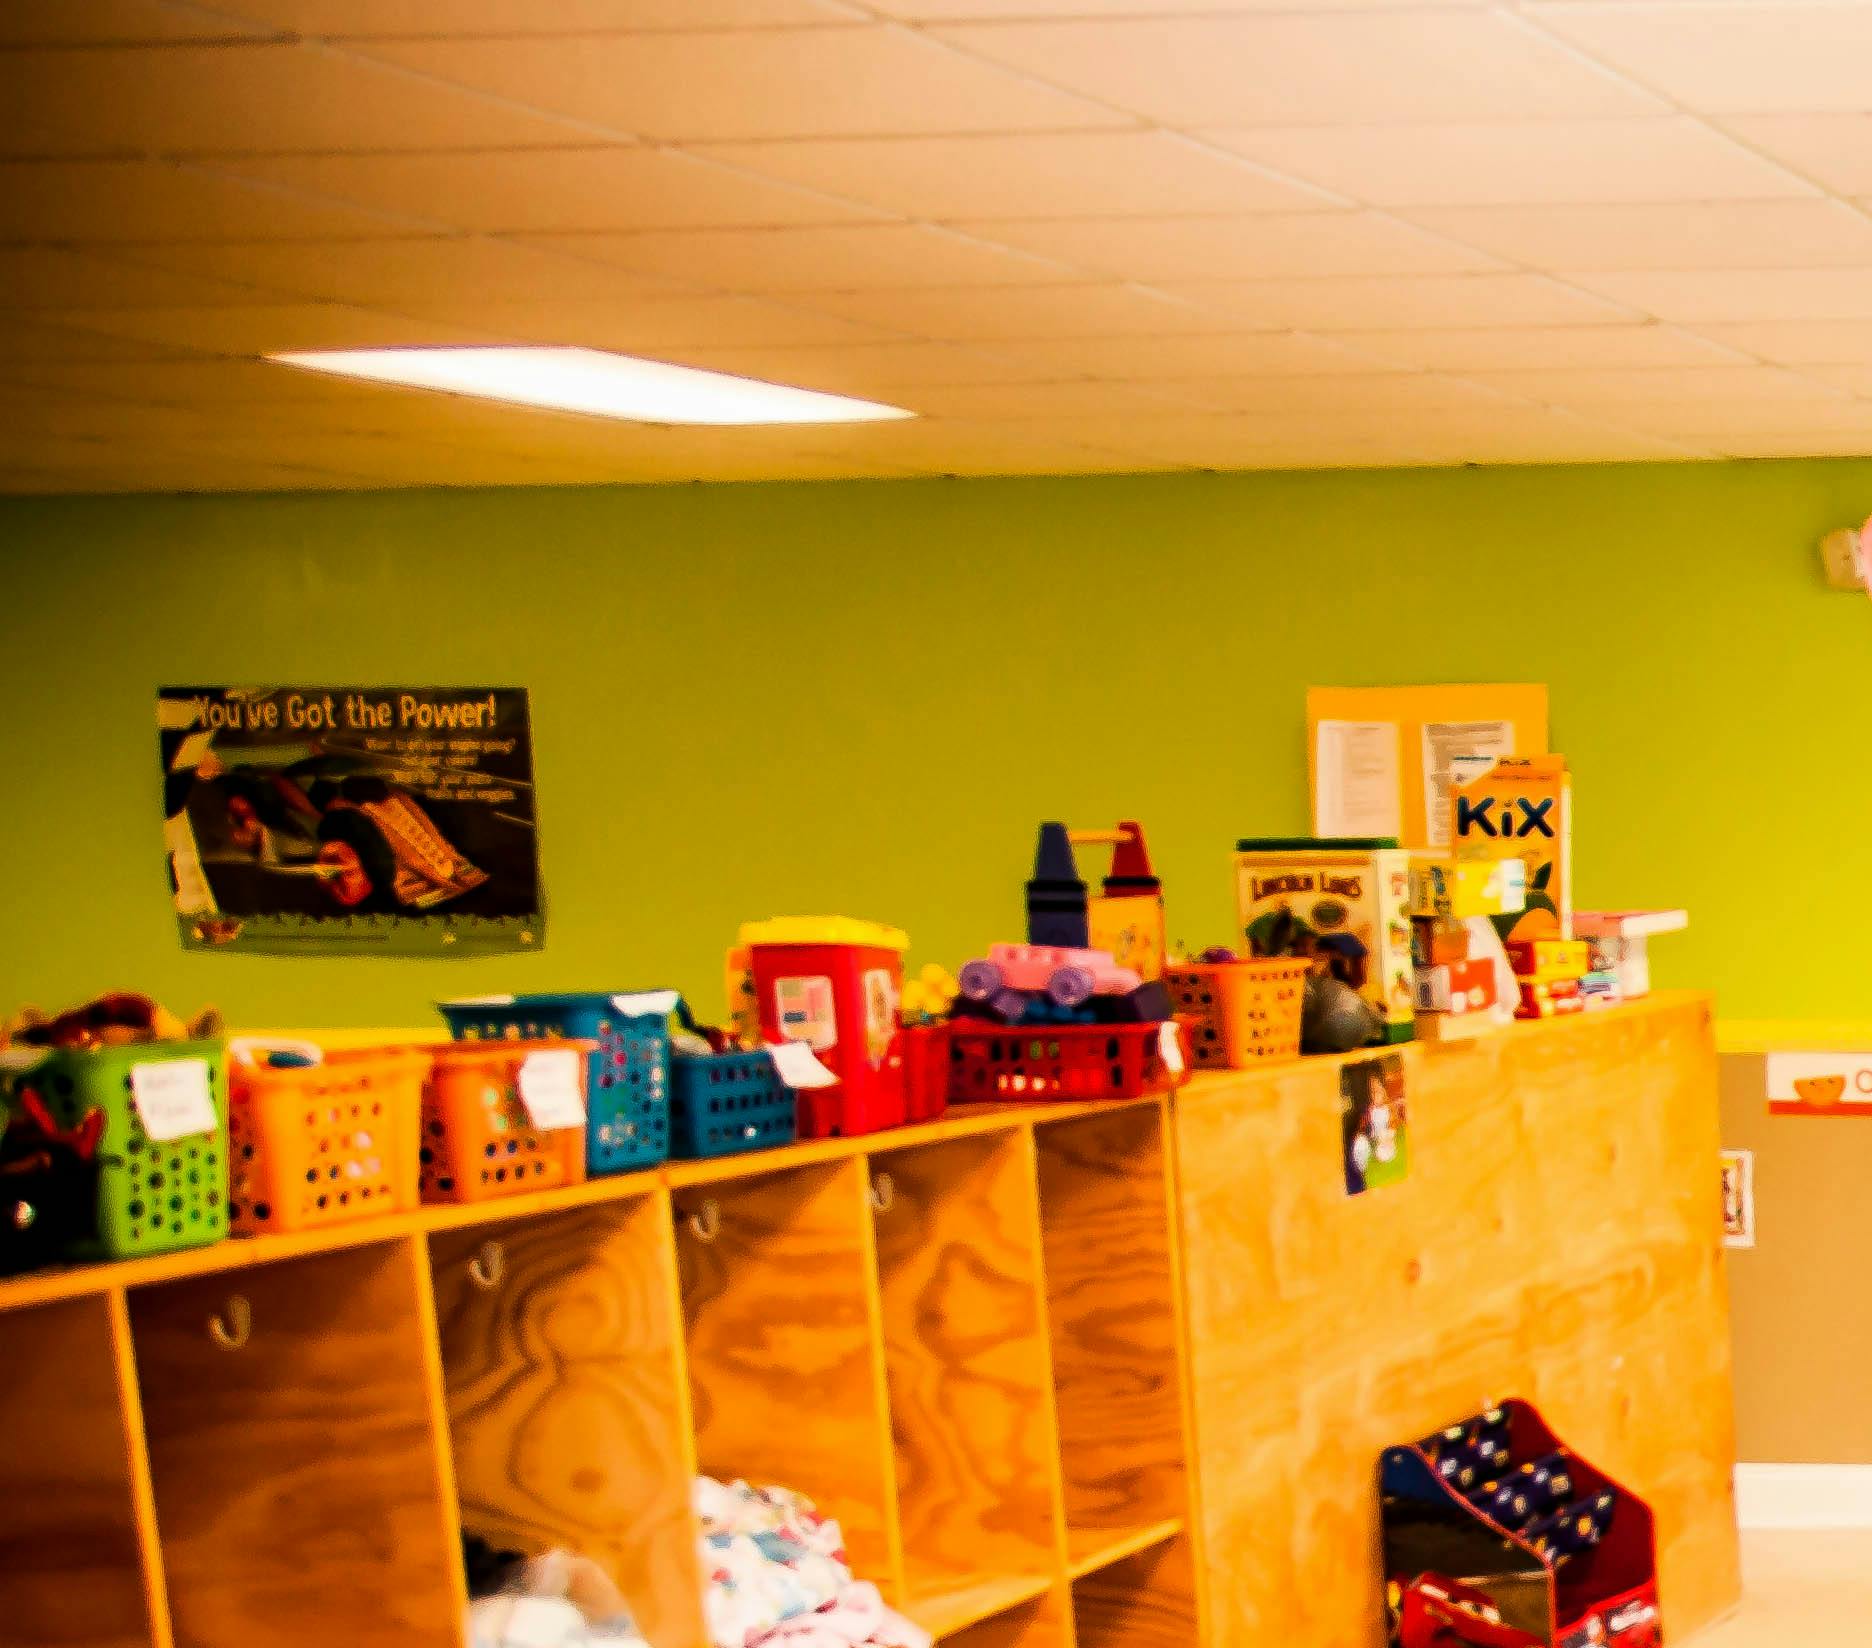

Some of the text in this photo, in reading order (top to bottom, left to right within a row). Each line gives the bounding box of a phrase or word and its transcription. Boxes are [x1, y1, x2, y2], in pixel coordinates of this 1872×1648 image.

[287, 694, 336, 730] Got
[347, 696, 392, 729] the
[399, 693, 497, 729] Power!
